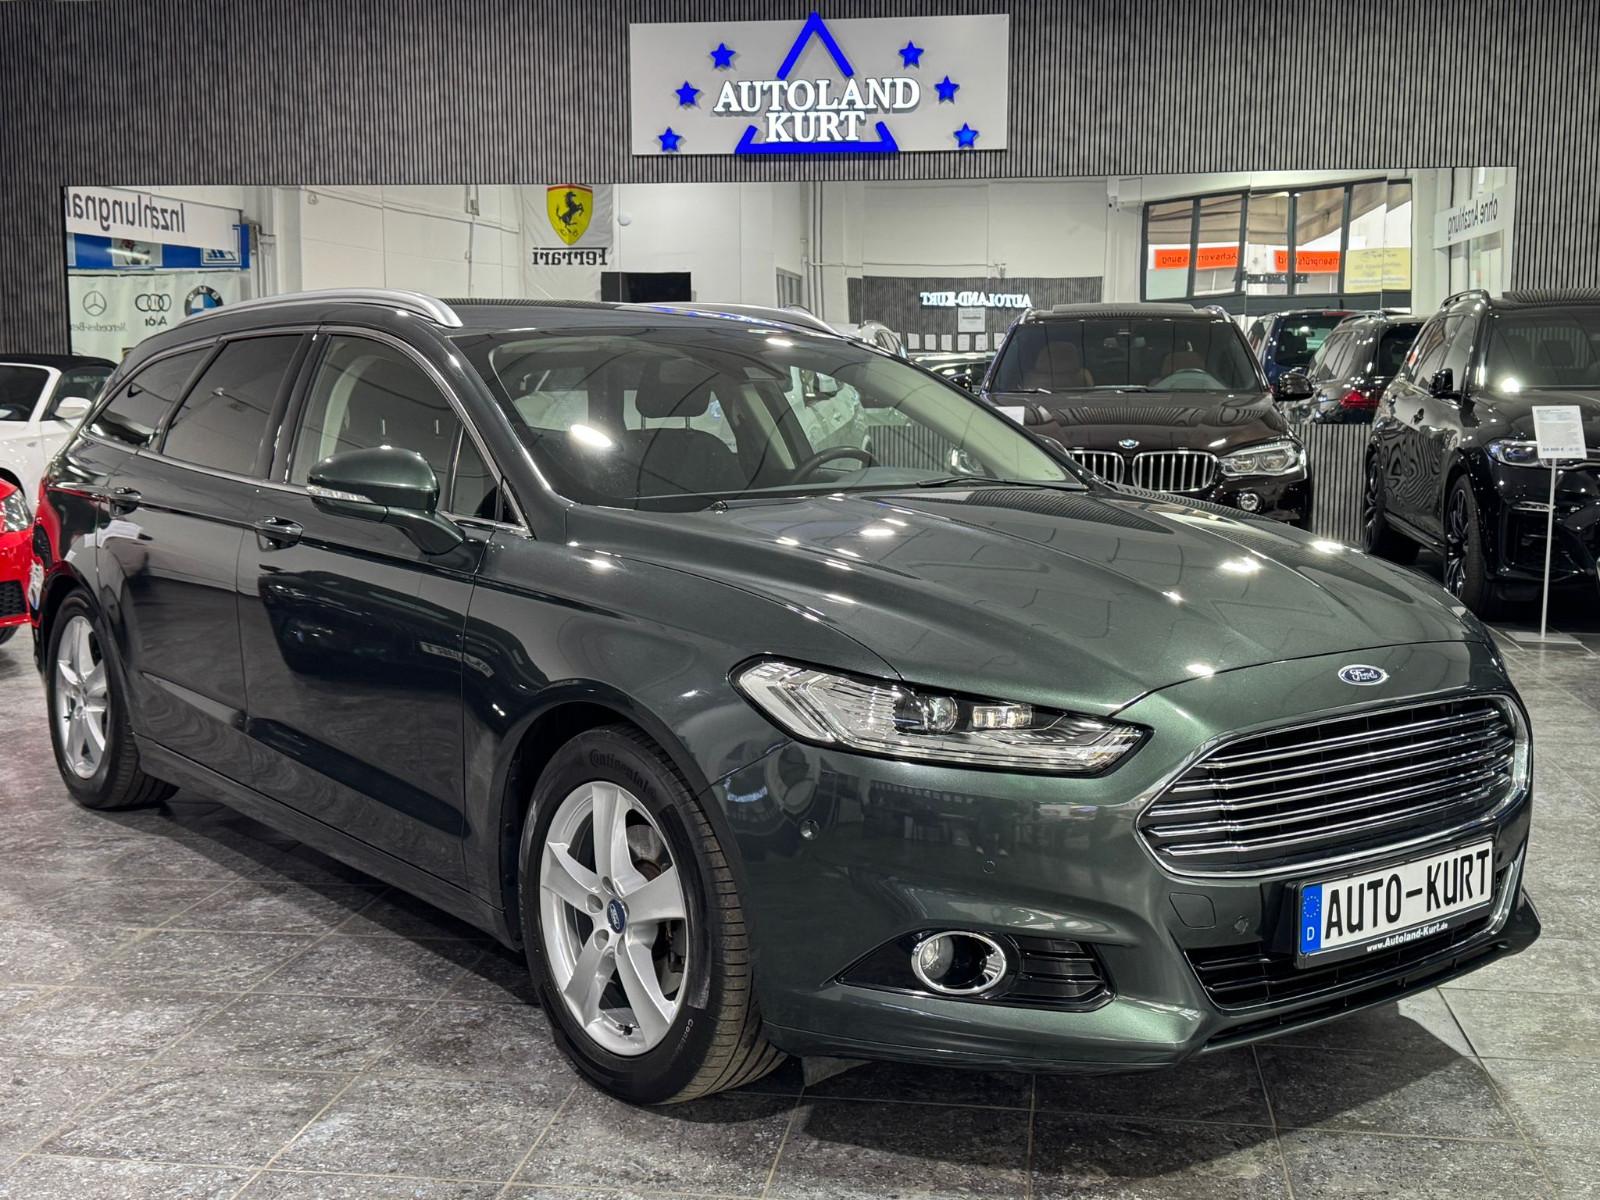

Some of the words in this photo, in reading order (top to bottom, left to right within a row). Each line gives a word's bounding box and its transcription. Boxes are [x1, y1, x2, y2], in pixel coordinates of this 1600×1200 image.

[713, 77, 921, 112] AUTOLAND
[765, 111, 866, 143] KURT
[1349, 668, 1378, 682] Ford
[1325, 849, 1490, 939] AUTO-KURT
[1306, 927, 1315, 941] D
[1366, 922, 1448, 952] www.Autoland-Kurt.de
